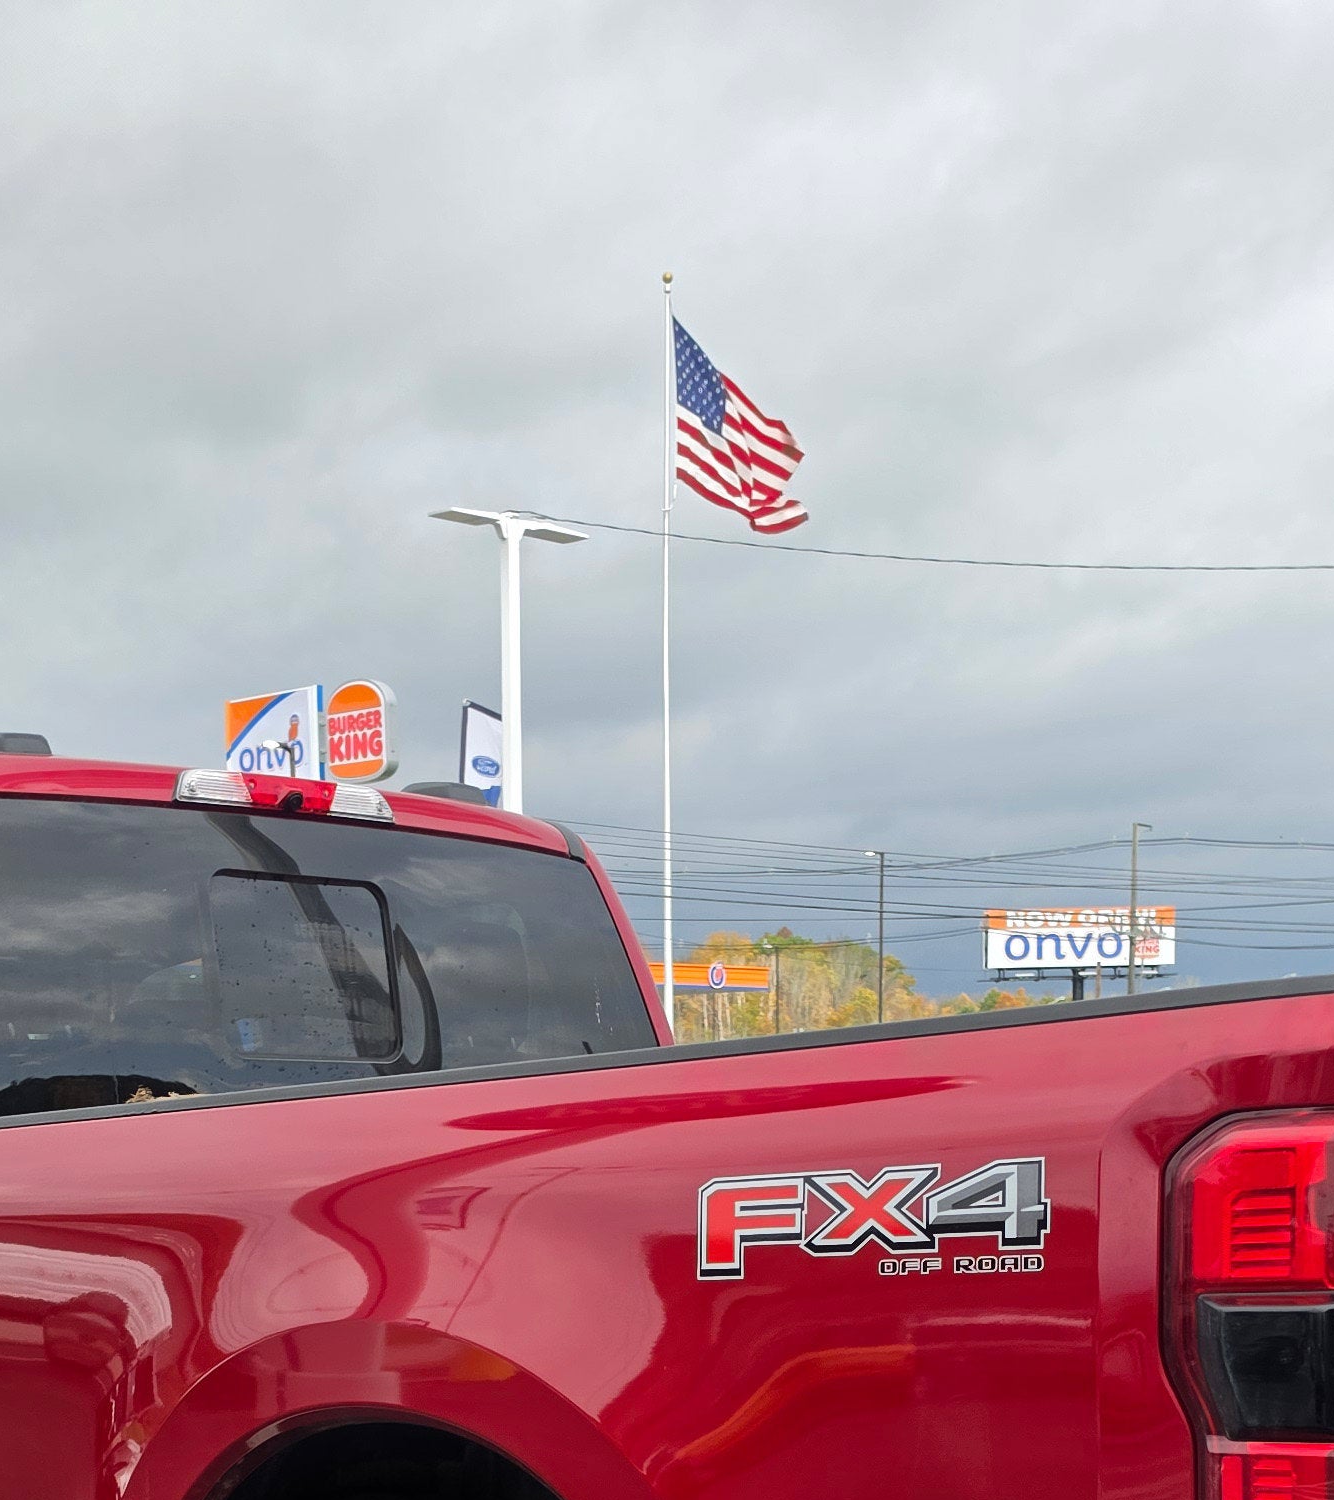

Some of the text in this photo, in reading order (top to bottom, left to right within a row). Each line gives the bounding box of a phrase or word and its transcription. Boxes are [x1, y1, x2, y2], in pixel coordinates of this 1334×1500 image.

[328, 709, 382, 737] BURGER
[328, 729, 383, 765] KING
[1006, 910, 1074, 928] NOW
[1004, 932, 1123, 960] onvo
[697, 1157, 1051, 1280] FX4
[878, 1254, 1045, 1276] OFF ROAD
